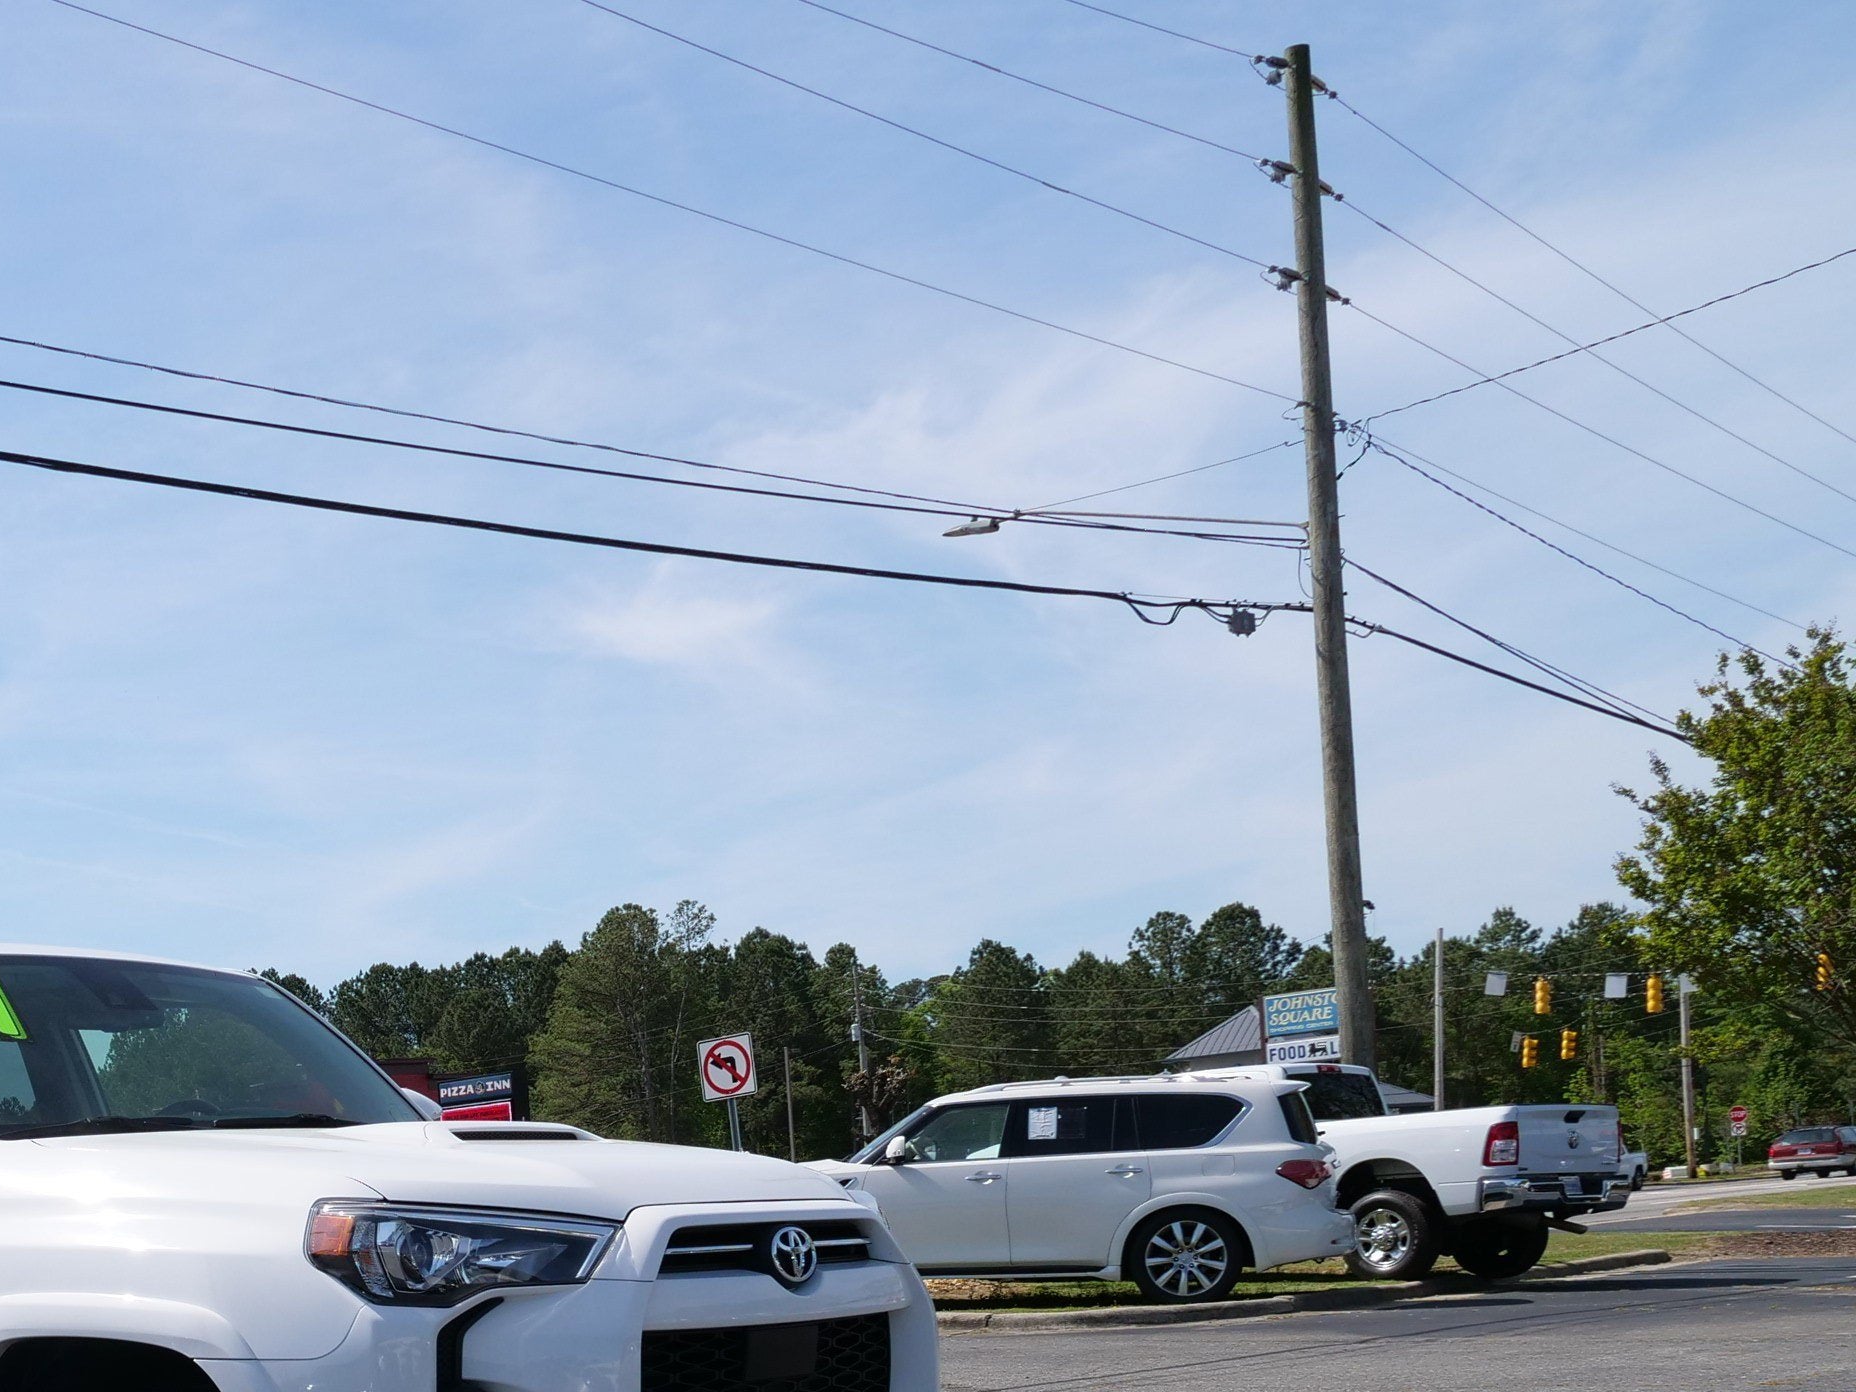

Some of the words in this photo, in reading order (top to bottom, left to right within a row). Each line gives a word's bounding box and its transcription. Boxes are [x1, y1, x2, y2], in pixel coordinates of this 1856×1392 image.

[1270, 1006, 1334, 1027] SQUARE
[1269, 1045, 1306, 1062] FOOD
[440, 1084, 475, 1098] PIZZA
[485, 1078, 511, 1092] INN
[1730, 1110, 1746, 1118] STOP
